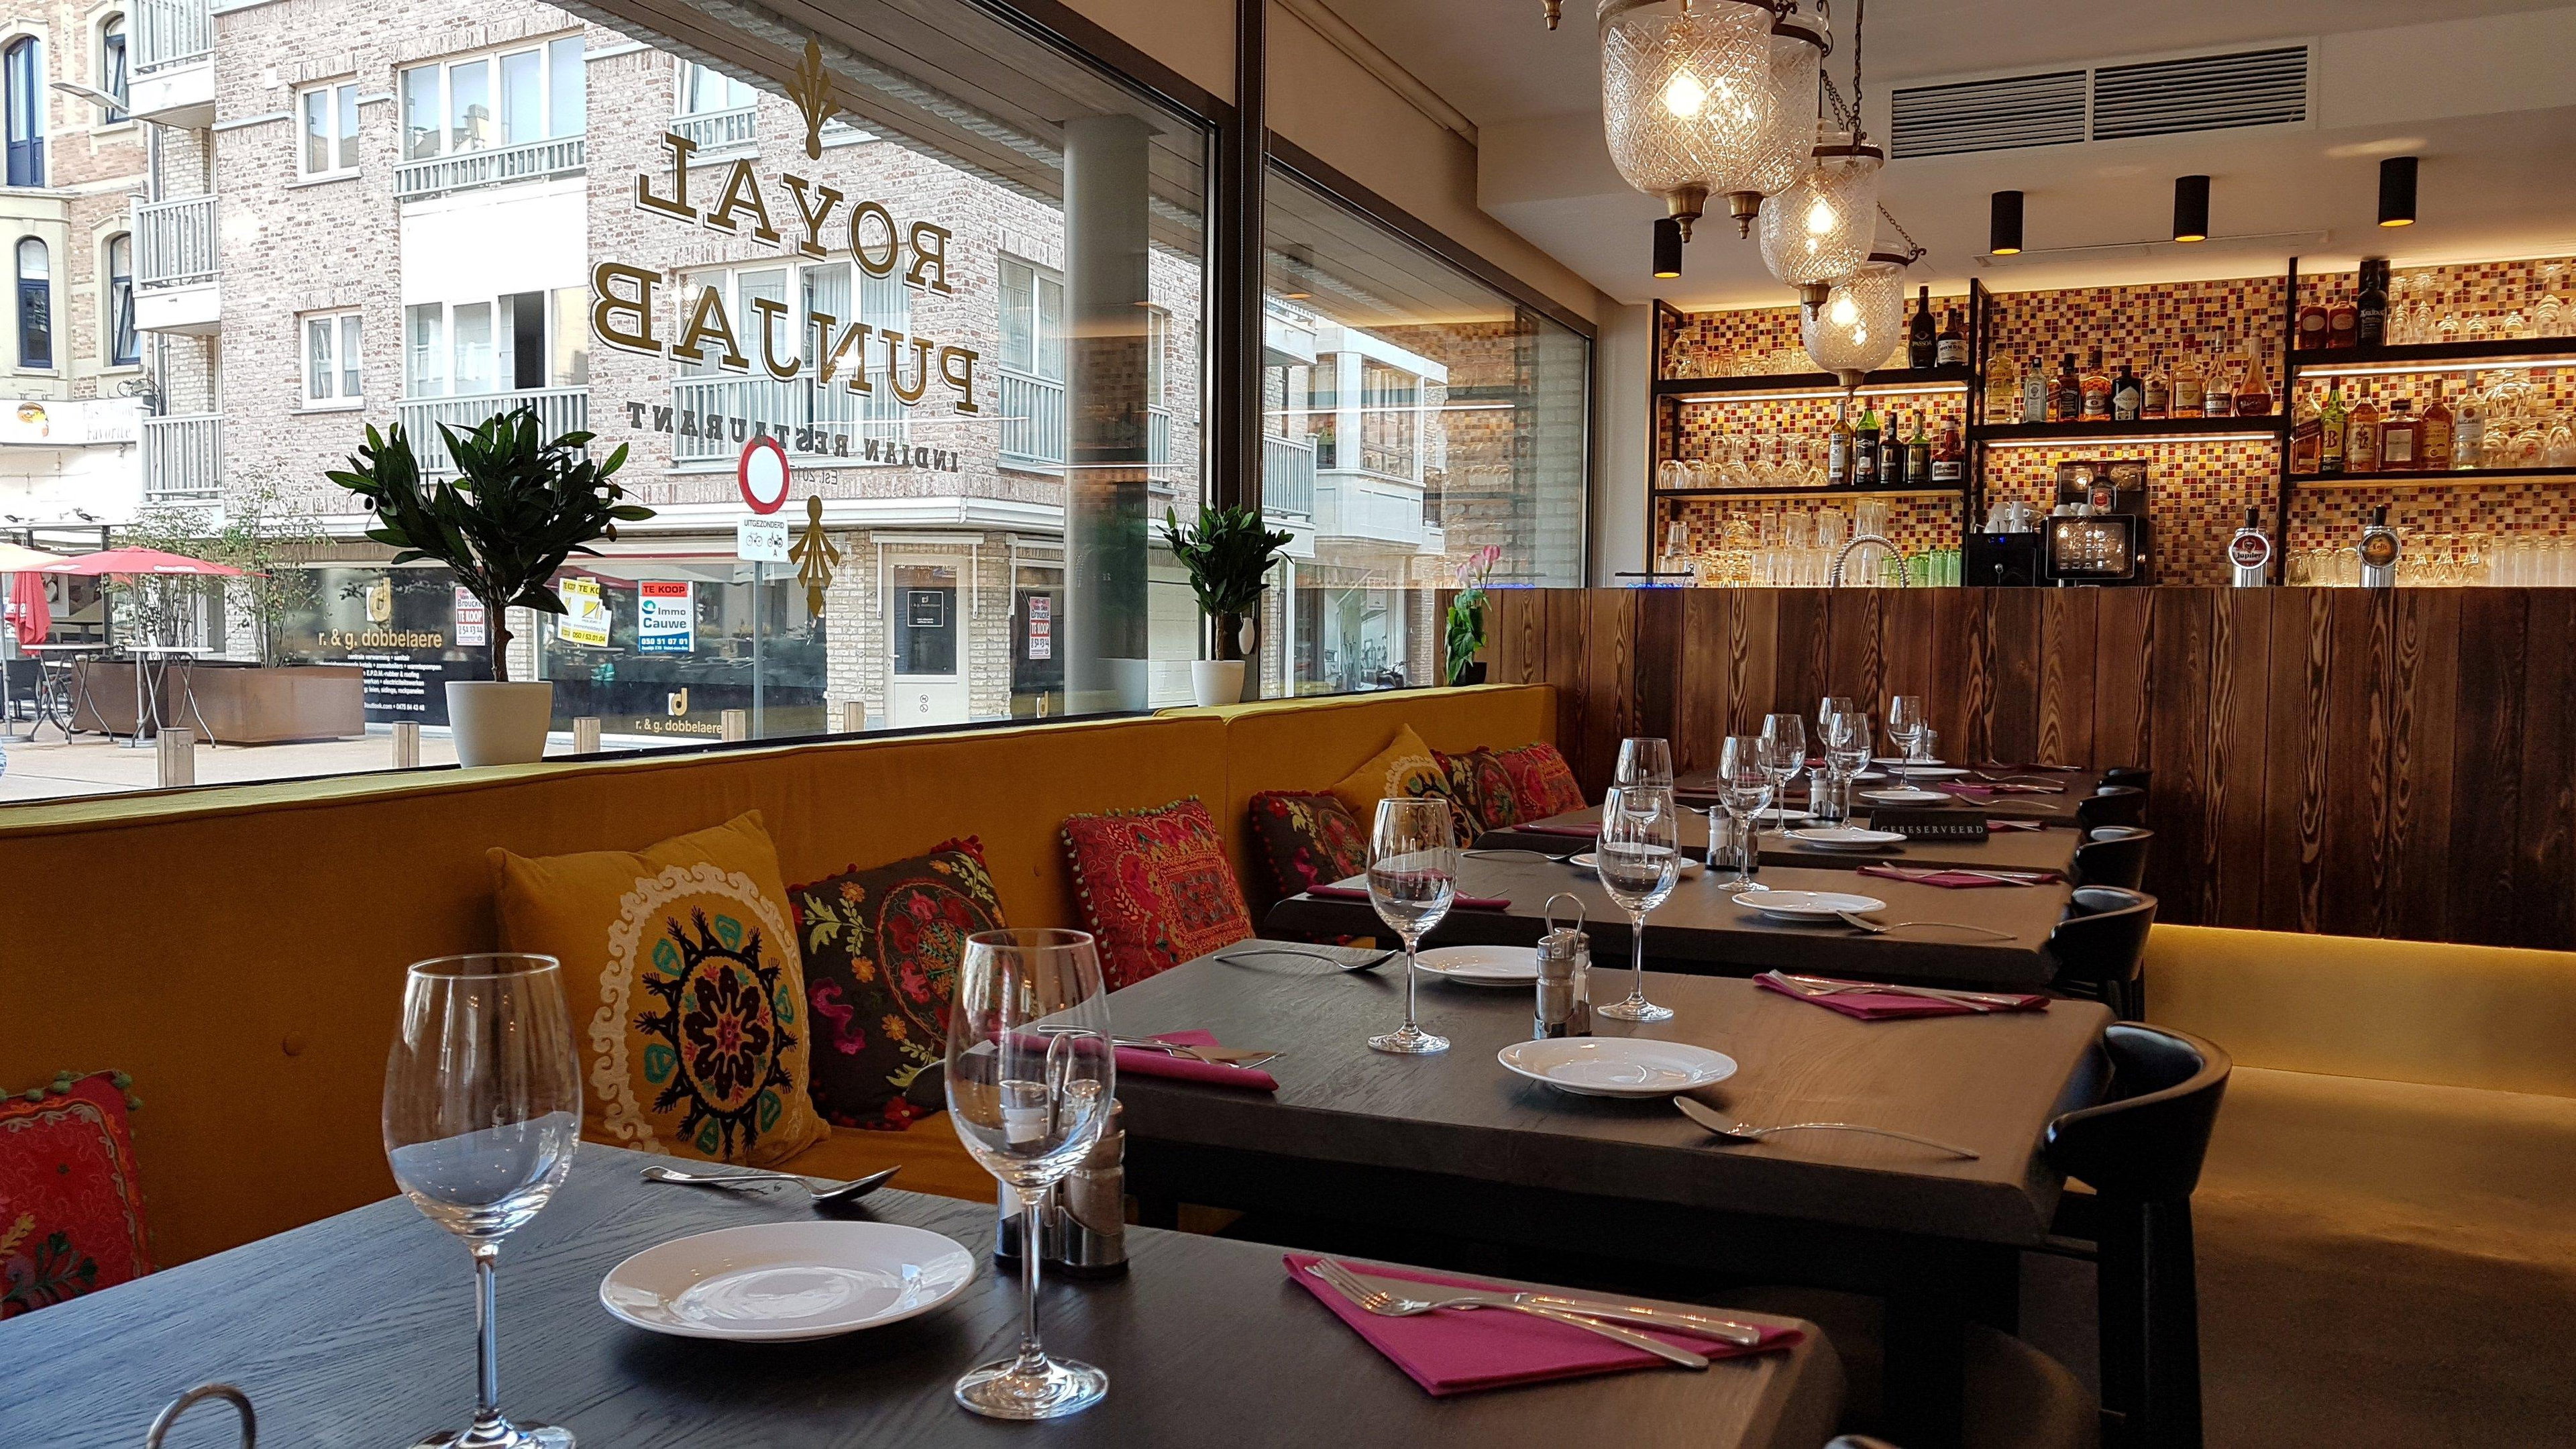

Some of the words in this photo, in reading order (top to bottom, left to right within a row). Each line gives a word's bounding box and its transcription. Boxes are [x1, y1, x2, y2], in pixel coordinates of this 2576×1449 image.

[744, 519, 784, 529] UITGEZONDERD
[773, 549, 777, 557] A
[458, 610, 464, 622] TE
[465, 610, 482, 623] KOOP
[658, 607, 686, 615] Immo
[643, 617, 687, 629] Cauwe
[318, 632, 327, 646] r.
[331, 628, 341, 646] &
[345, 632, 357, 650] g.
[362, 629, 442, 648] dobbelaere
[644, 718, 651, 730] &
[665, 720, 722, 733] dobbelaere
[1880, 826, 1984, 834] GERESERVEERD
